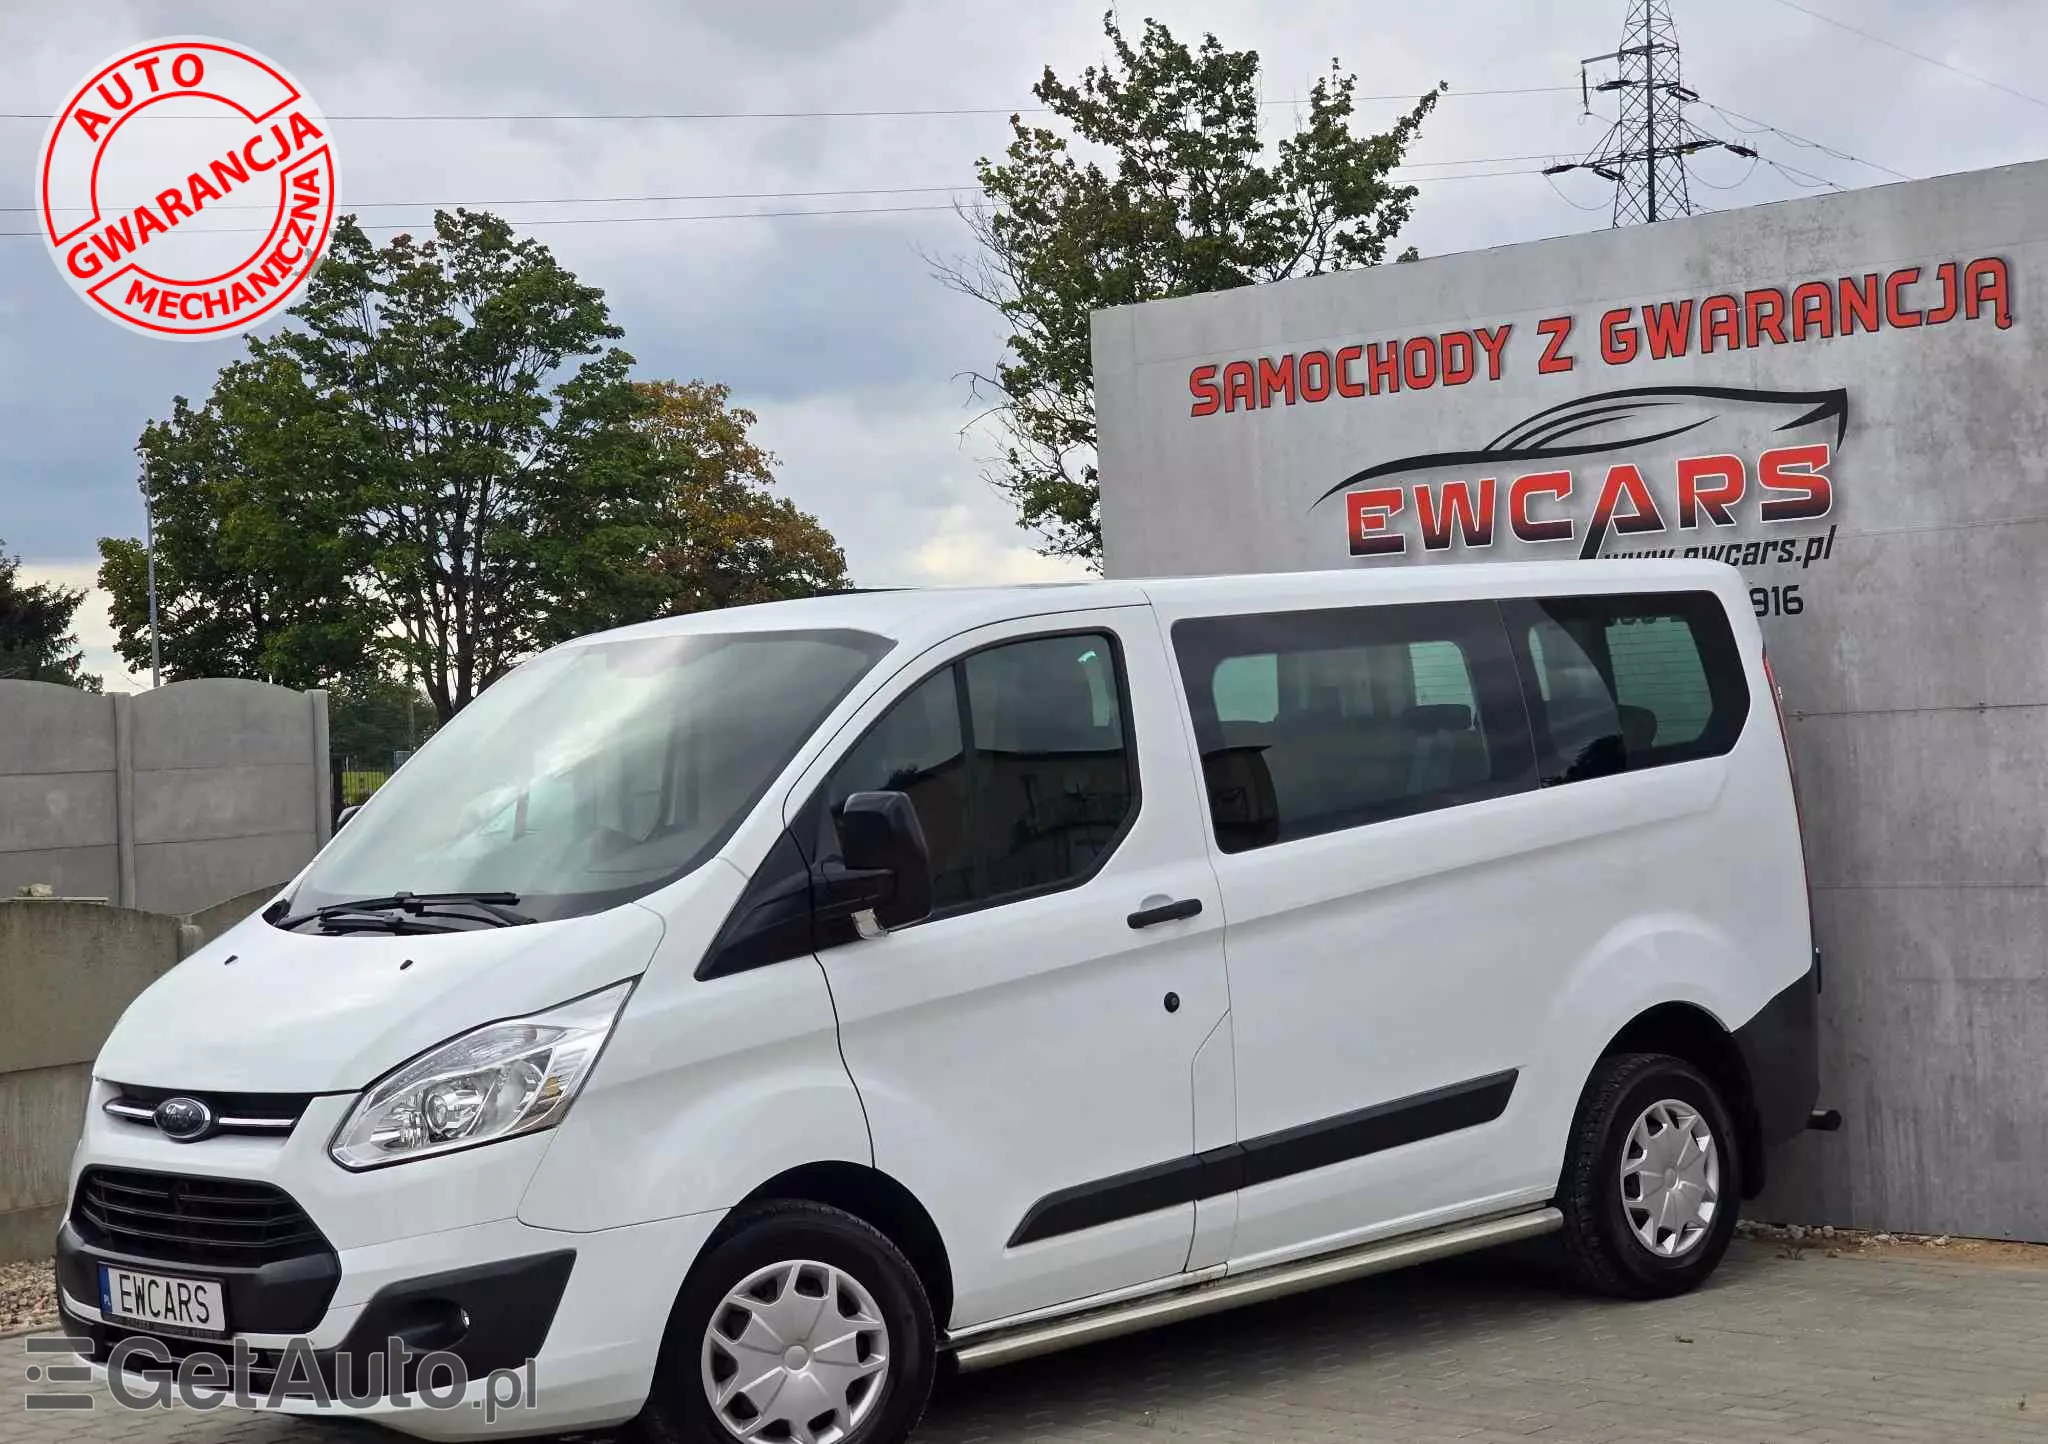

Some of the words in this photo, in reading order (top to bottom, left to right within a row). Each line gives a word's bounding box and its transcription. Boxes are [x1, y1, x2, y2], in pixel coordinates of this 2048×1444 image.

[1189, 323, 1513, 417] SAMOCHODY
[1536, 315, 1574, 375] Z
[1600, 256, 2013, 366] GWARANCJĄ
[1346, 443, 1834, 559] EWCARS
[1603, 524, 1837, 569] wcars.pl
[119, 1273, 210, 1324] EWCARS
